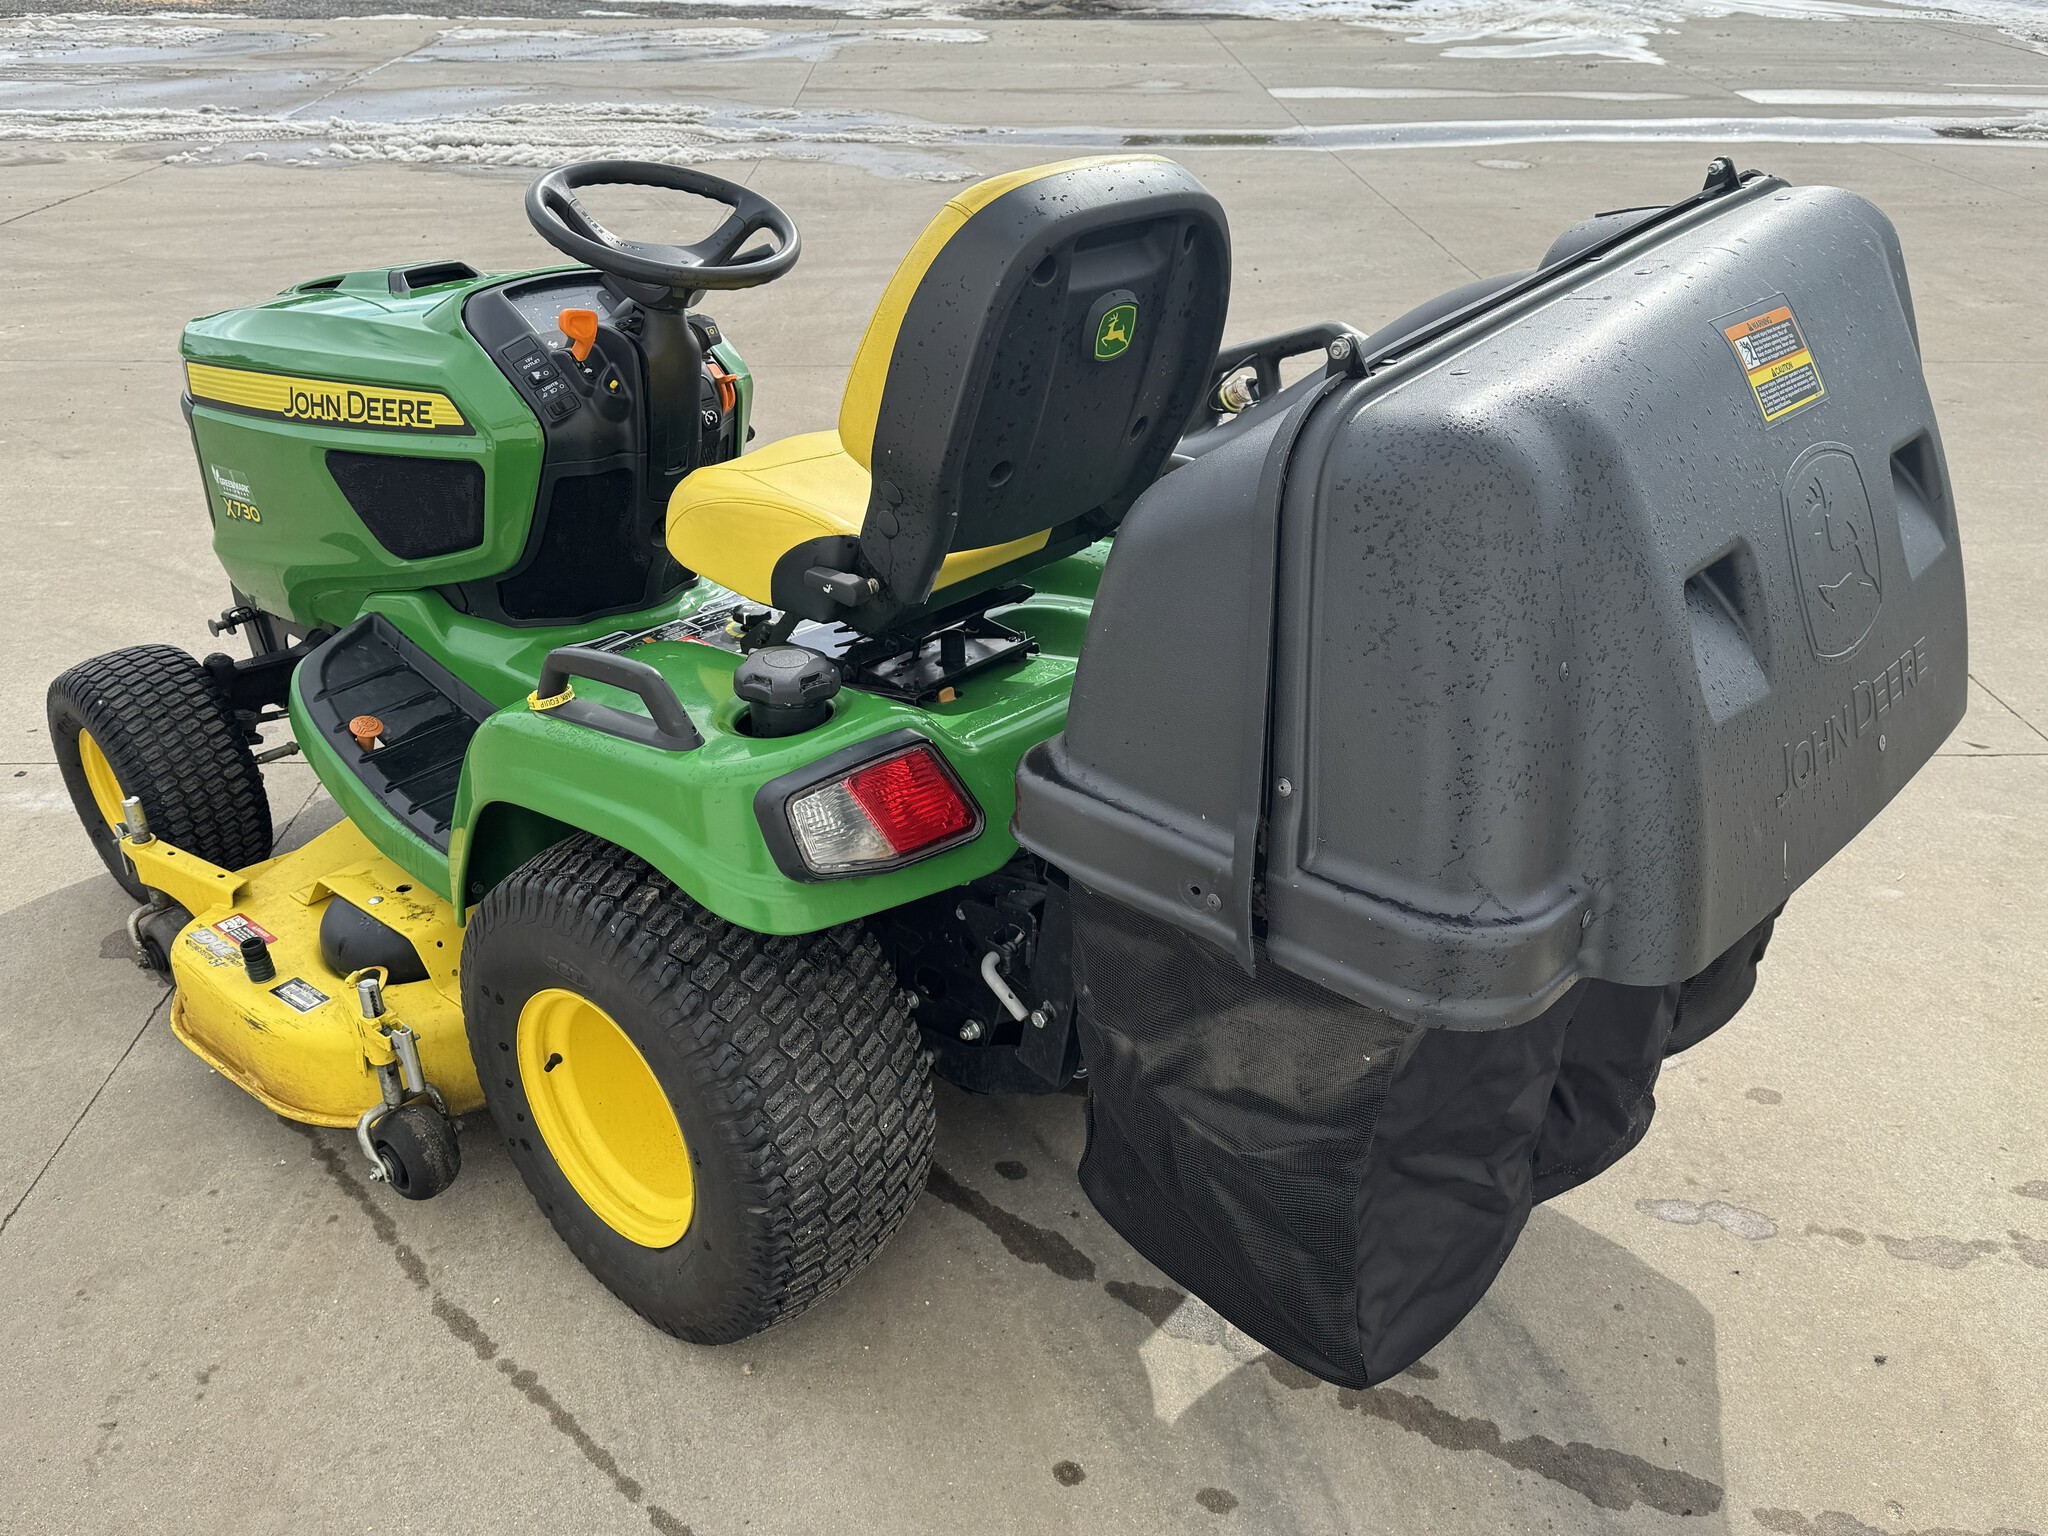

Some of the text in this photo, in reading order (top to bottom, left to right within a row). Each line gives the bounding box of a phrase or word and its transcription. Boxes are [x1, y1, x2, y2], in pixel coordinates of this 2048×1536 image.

[1753, 316, 1772, 329] WARNING
[523, 359, 540, 370] OUTLET
[1775, 362, 1793, 375] CAUTION
[542, 381, 559, 392] LIGHTS
[283, 386, 433, 425] JOHN DEERE
[223, 497, 261, 523] X730
[541, 698, 559, 708] EQUIP
[1775, 636, 1928, 808] JOHN DEERE
[187, 928, 238, 958] EDGE
